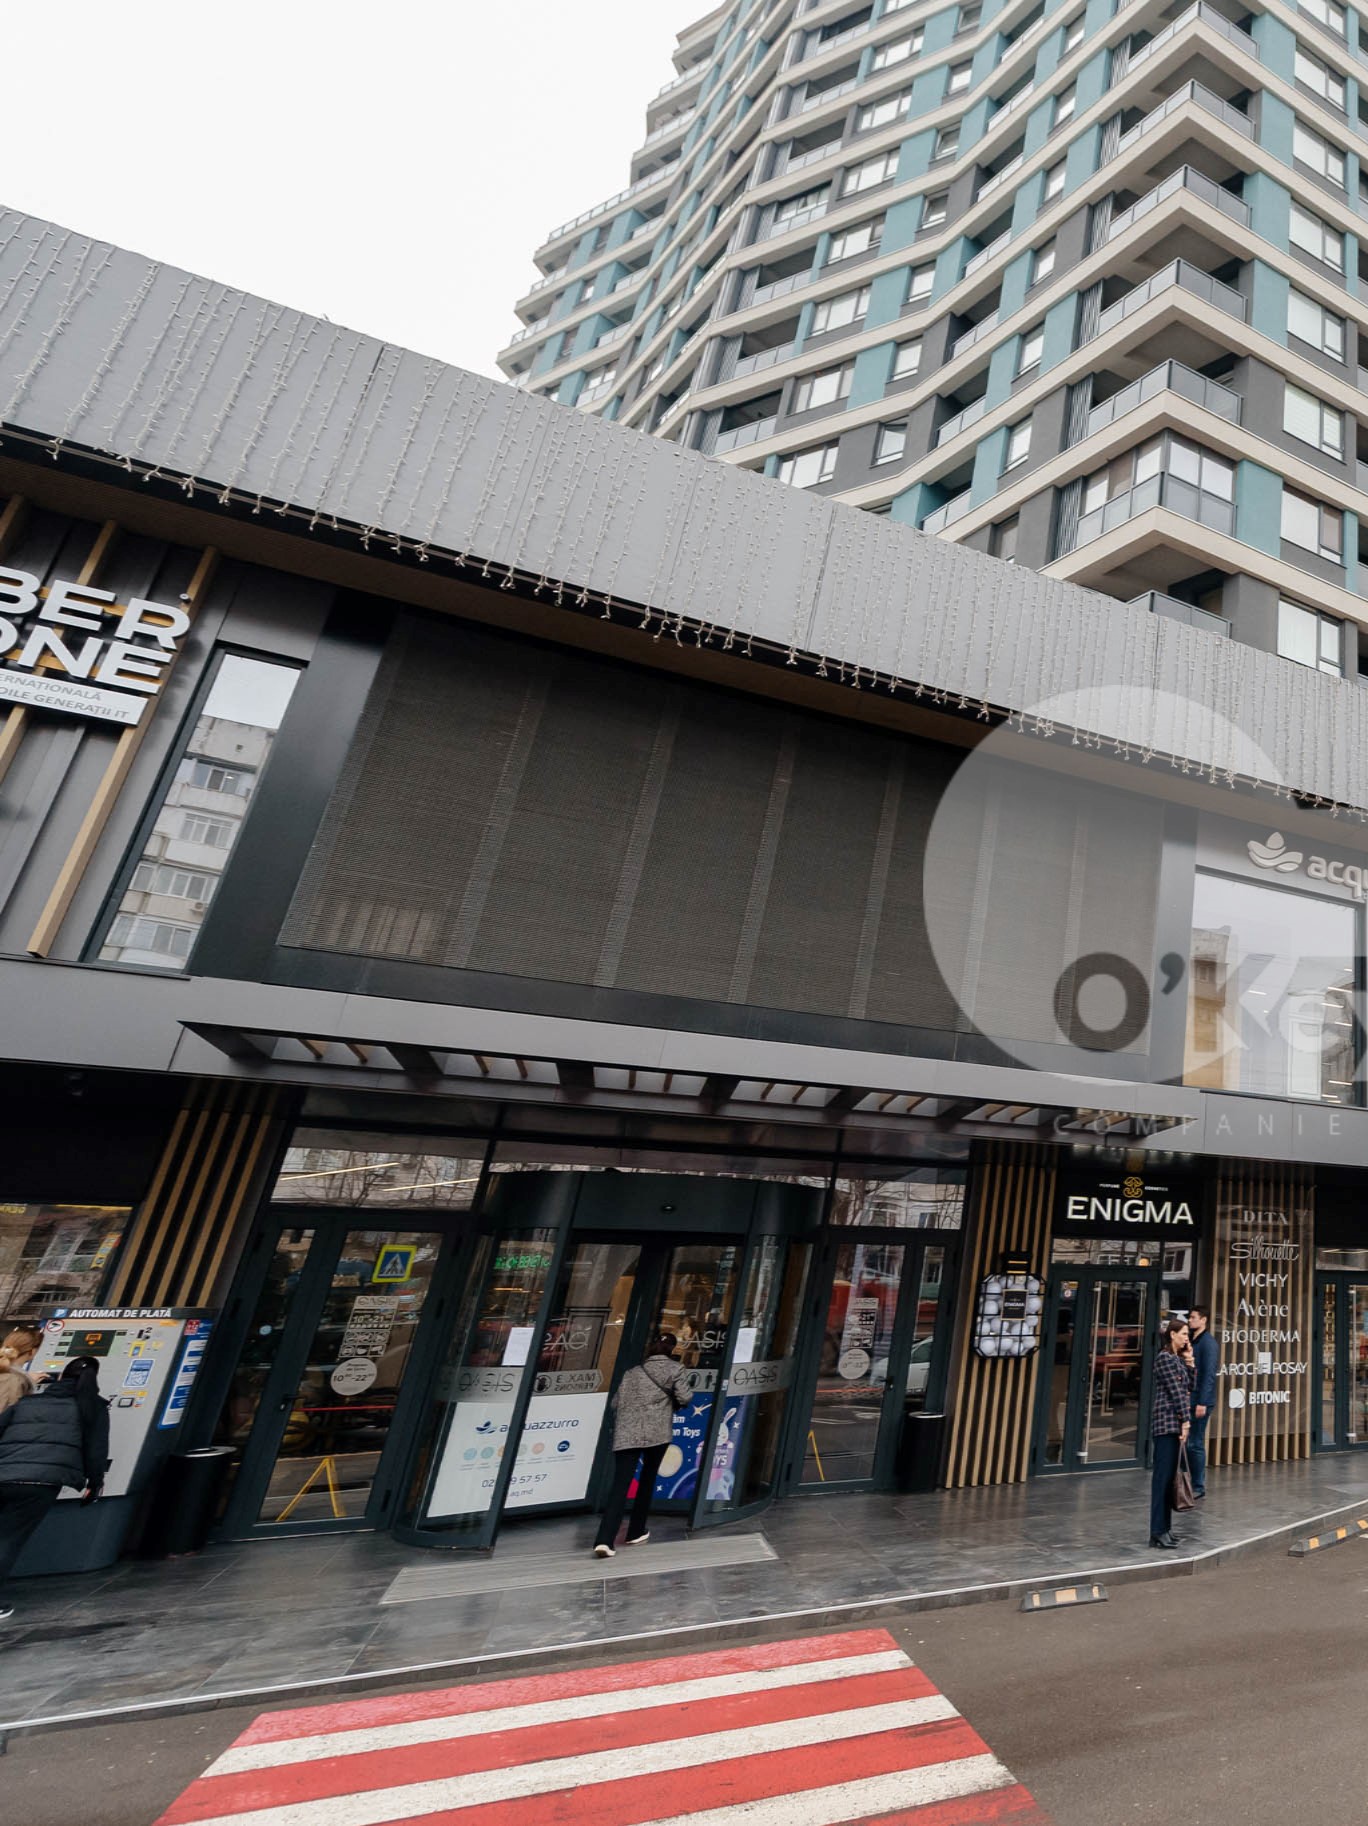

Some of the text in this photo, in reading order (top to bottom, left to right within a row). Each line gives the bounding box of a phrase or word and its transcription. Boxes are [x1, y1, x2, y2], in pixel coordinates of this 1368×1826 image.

[114, 709, 130, 719] IT
[1067, 1196, 1194, 1225] ENIGMA
[1243, 1210, 1289, 1225] DITA
[1239, 1273, 1288, 1287] VICHY
[69, 1309, 122, 1318] AUTOMAT
[124, 1309, 138, 1318] DE
[1237, 1297, 1289, 1317] Avène
[1222, 1329, 1300, 1344] BIODERMA
[1272, 1361, 1307, 1375] POSAY
[734, 1366, 778, 1385] OASIS
[500, 1418, 580, 1433] auazzurro
[682, 1427, 701, 1438] Toys
[519, 1474, 533, 1484] 57
[535, 1473, 548, 1483] 57
